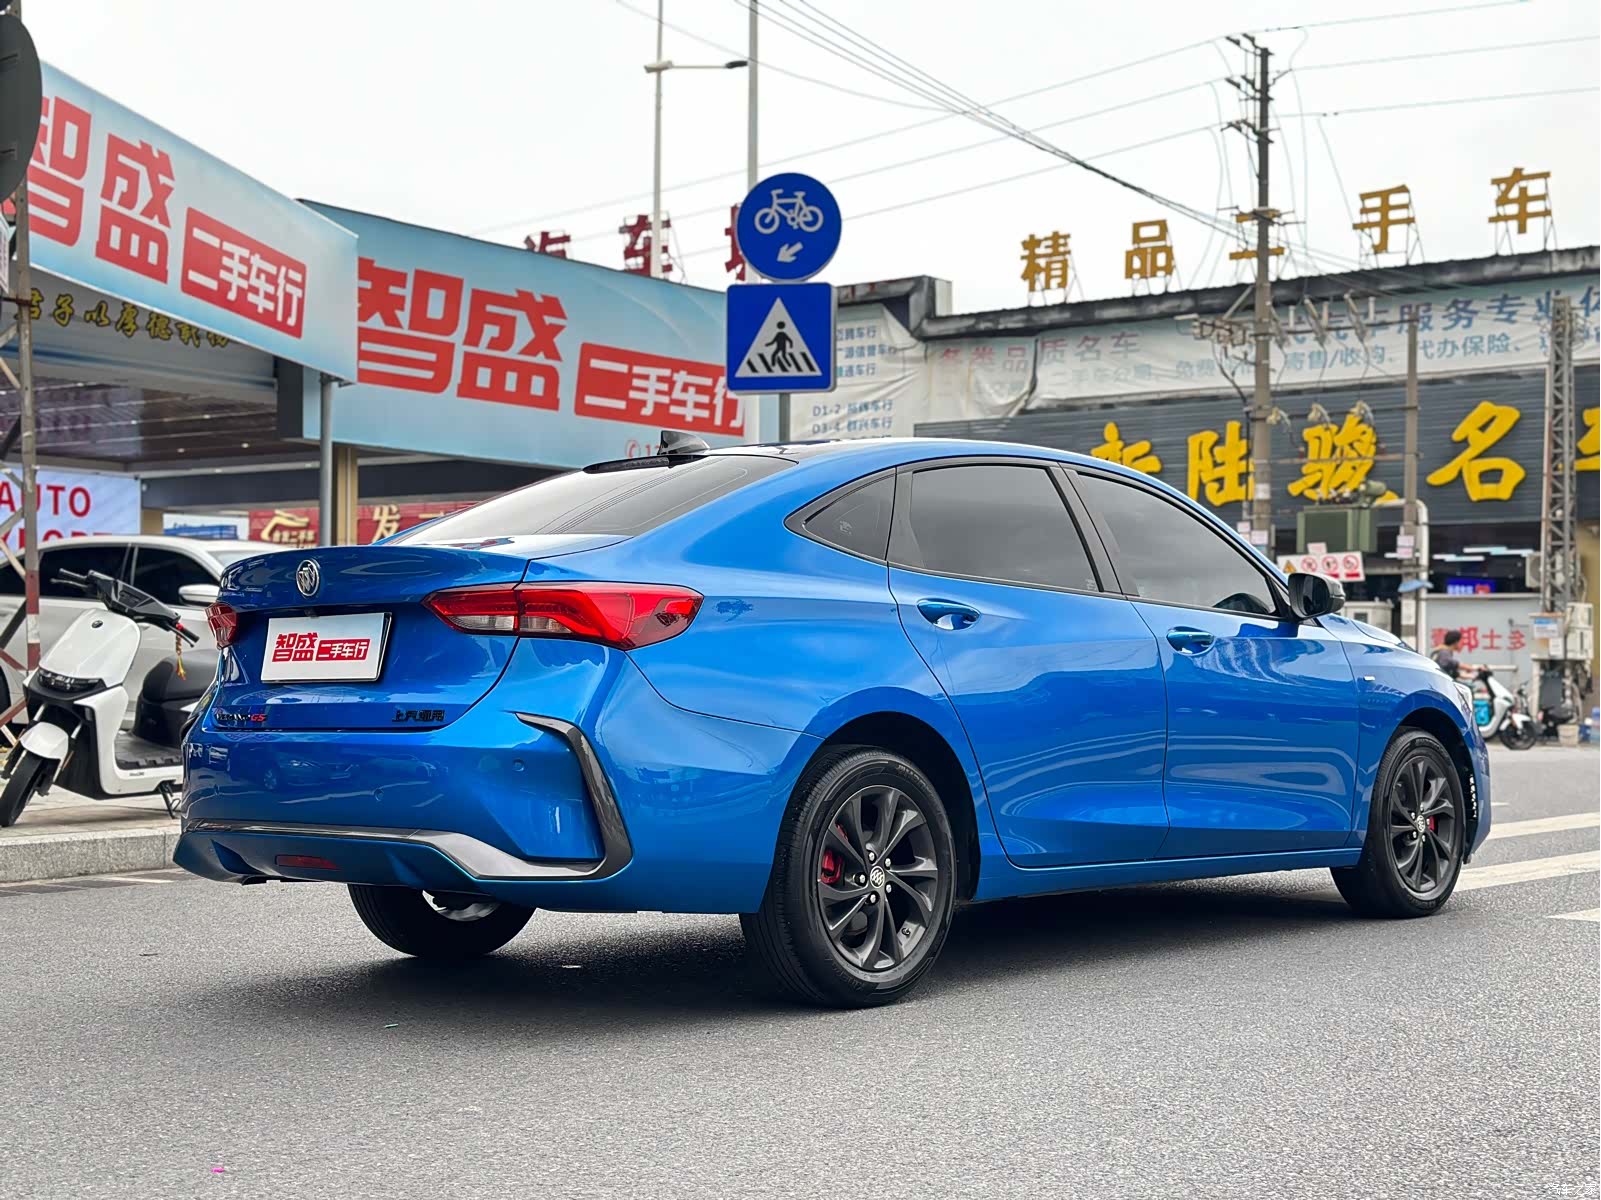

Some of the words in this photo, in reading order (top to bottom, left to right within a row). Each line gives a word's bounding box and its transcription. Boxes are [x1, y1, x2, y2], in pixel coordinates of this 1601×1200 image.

[28, 96, 175, 284] 智盛
[186, 226, 304, 328] 二手车行
[1020, 167, 1552, 292] 精品二手车
[358, 256, 567, 412] 智盛
[585, 358, 745, 428] 二手车行
[272, 633, 318, 662] 智盛
[319, 642, 369, 660] 二手车行
